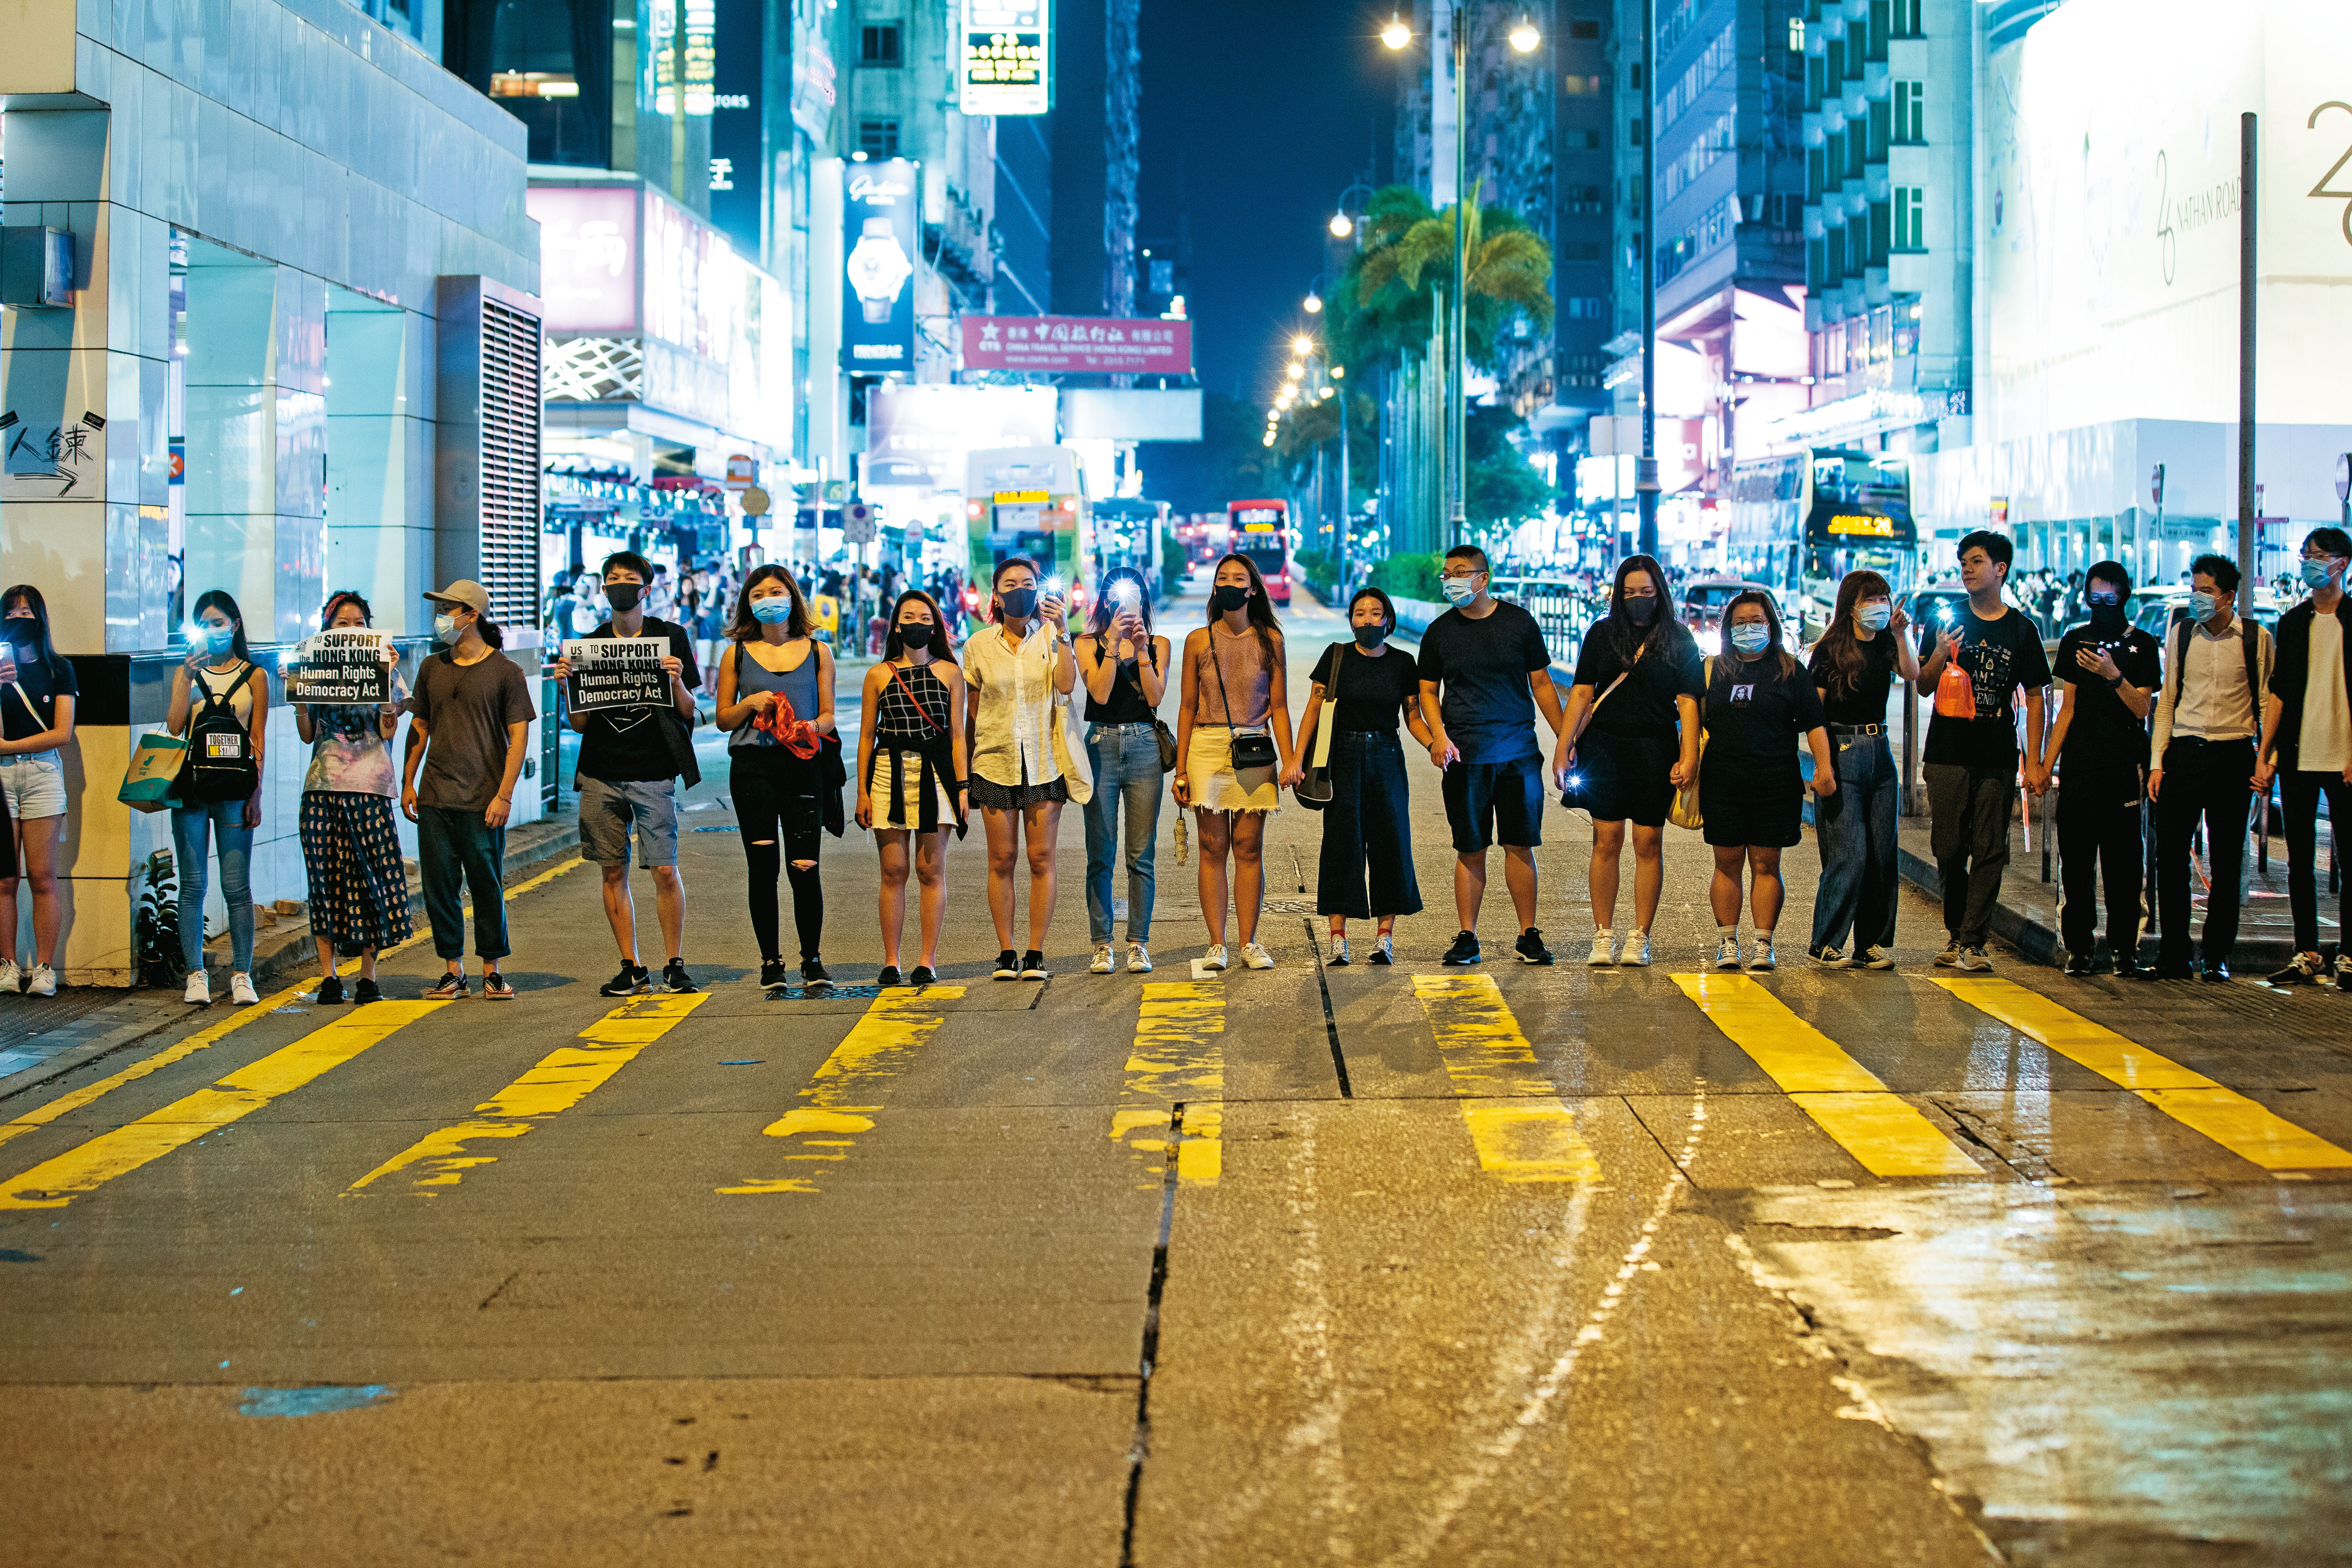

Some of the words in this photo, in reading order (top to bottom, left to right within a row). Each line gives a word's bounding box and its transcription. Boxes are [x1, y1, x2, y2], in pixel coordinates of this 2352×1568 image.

[2156, 149, 2175, 286] 26
[2177, 188, 2213, 234] NATHAN
[2216, 176, 2242, 220] ROAD
[1005, 342, 1030, 352] CHINA
[1031, 343, 1058, 352] TRAVEL
[1060, 343, 1091, 353] SERVICE
[314, 635, 322, 644] TO
[323, 634, 382, 648] SUPPORT
[299, 654, 310, 662] the
[313, 649, 346, 663] HONG
[349, 649, 381, 662] KONG
[570, 646, 582, 655] US
[590, 644, 599, 654] TO
[601, 643, 659, 658] SUPPORT
[591, 659, 625, 670] HONG
[627, 659, 661, 670] KONG
[300, 666, 339, 680] Human
[342, 665, 376, 683] Rights
[580, 673, 619, 687] Human
[622, 672, 658, 687] Rights
[1971, 670, 1988, 683] AM
[296, 682, 360, 700] Democracy
[362, 682, 380, 697] Act
[578, 688, 641, 704] Democracy
[645, 685, 662, 699] Act
[209, 734, 238, 745] TOGETHER
[209, 745, 219, 756] WE
[219, 745, 238, 756] STAND
